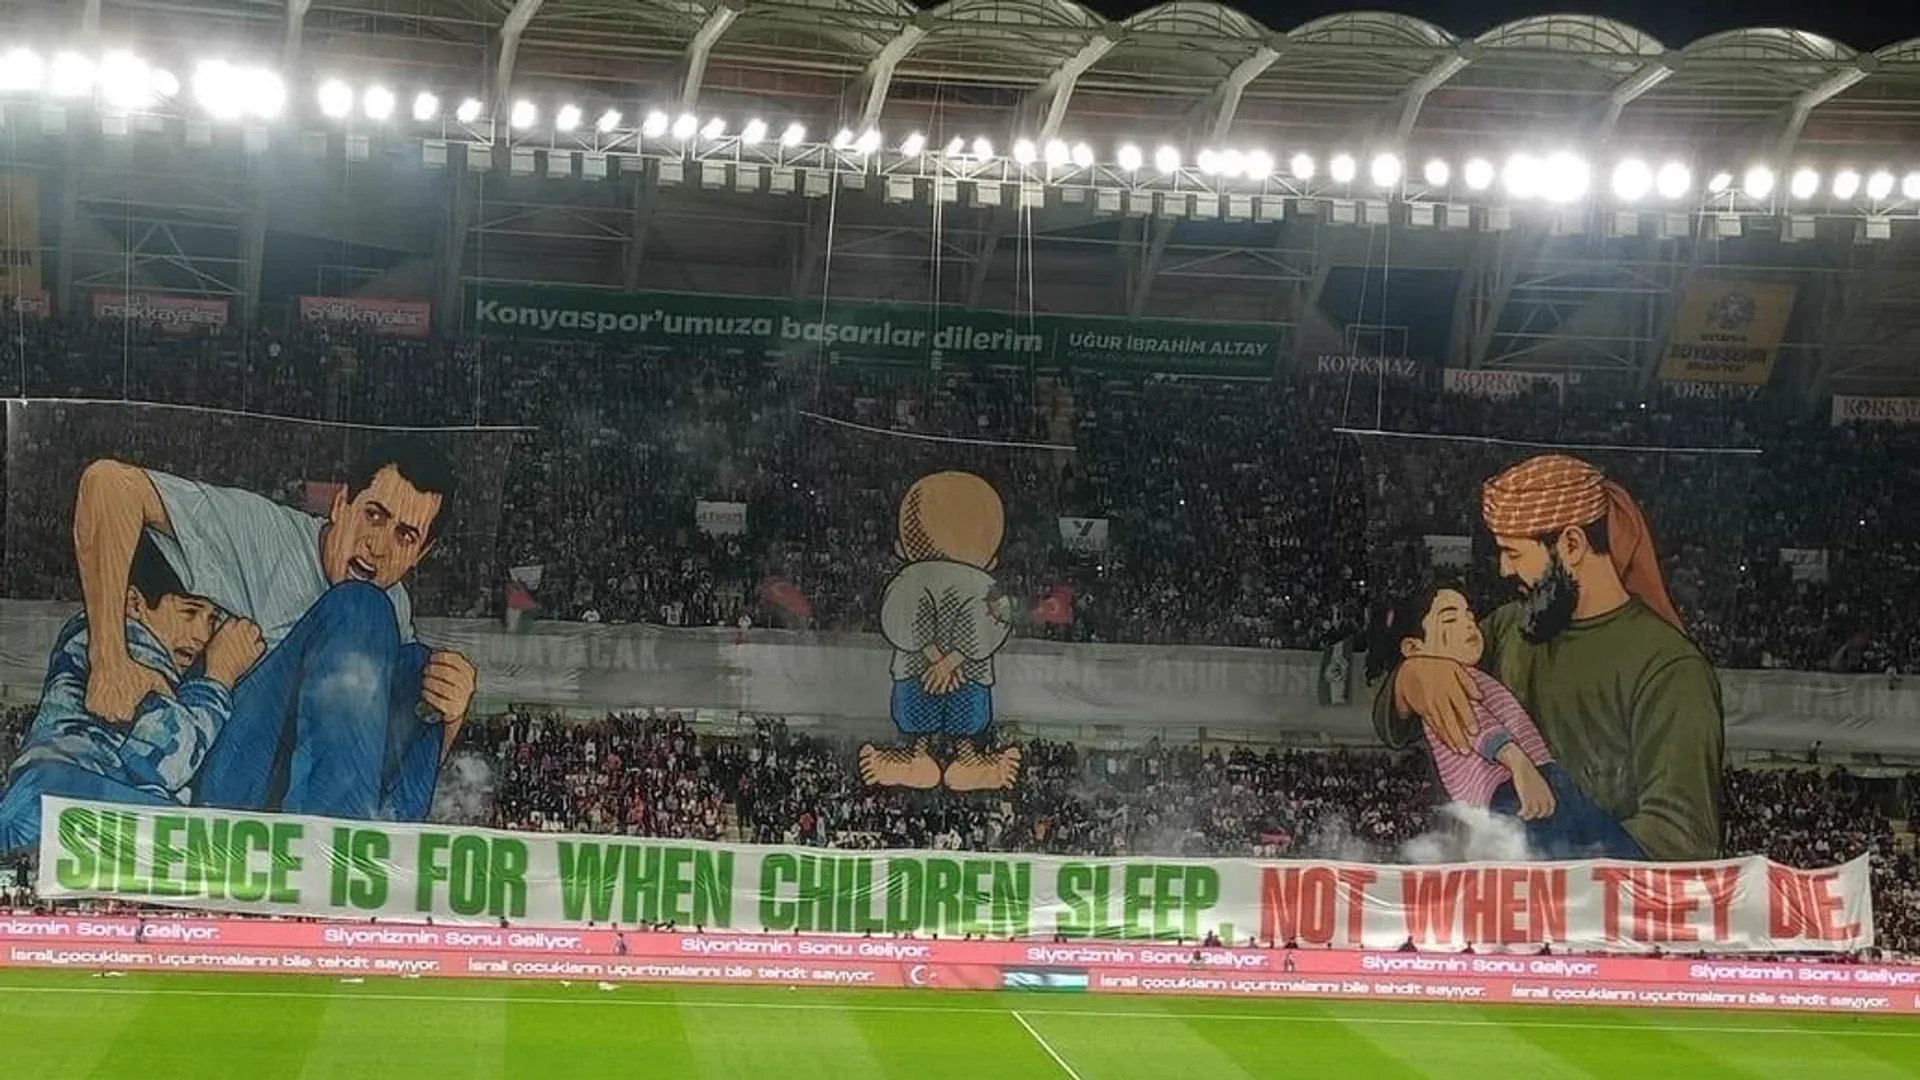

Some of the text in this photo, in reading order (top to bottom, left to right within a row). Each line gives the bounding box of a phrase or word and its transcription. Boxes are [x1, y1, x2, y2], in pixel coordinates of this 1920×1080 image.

[475, 299, 1042, 352] Konyaspor'umuza başarılar dilerim
[1069, 330, 1268, 356] UĞUR İBRAHİM ALTAY
[1317, 355, 1418, 378] KORKMAZ
[56, 806, 1862, 945] SILENCE IS FOR WHEN CHILDREN SLEEP. NOT WHEN THEY DIE.
[76, 922, 135, 937] Sonu
[143, 922, 221, 941] Geliyor.
[323, 928, 582, 950] Siyonizmin Sonu Geliyor.
[681, 937, 931, 960] Siyonizmin Sonu Geliyor.
[1027, 947, 1134, 964] Siyonizmin
[1141, 950, 1193, 964] Sonu
[282, 954, 312, 967] bile
[318, 955, 369, 969] tehdit
[1362, 955, 1599, 977] Siyonizmin Sonu Geliyor.
[724, 965, 752, 978] bile
[758, 966, 807, 980] tehdit
[812, 969, 875, 983] sayıyor.
[1688, 963, 1793, 981] Siyonizmin
[1799, 967, 1850, 982] Sonu
[1343, 979, 1369, 993] bile
[1374, 981, 1423, 995] tehdit
[1426, 984, 1487, 999] sayıyor.
[1748, 991, 1776, 1005] bile
[1780, 993, 1827, 1006] tehdit
[1830, 996, 1890, 1010] sayıyor.
